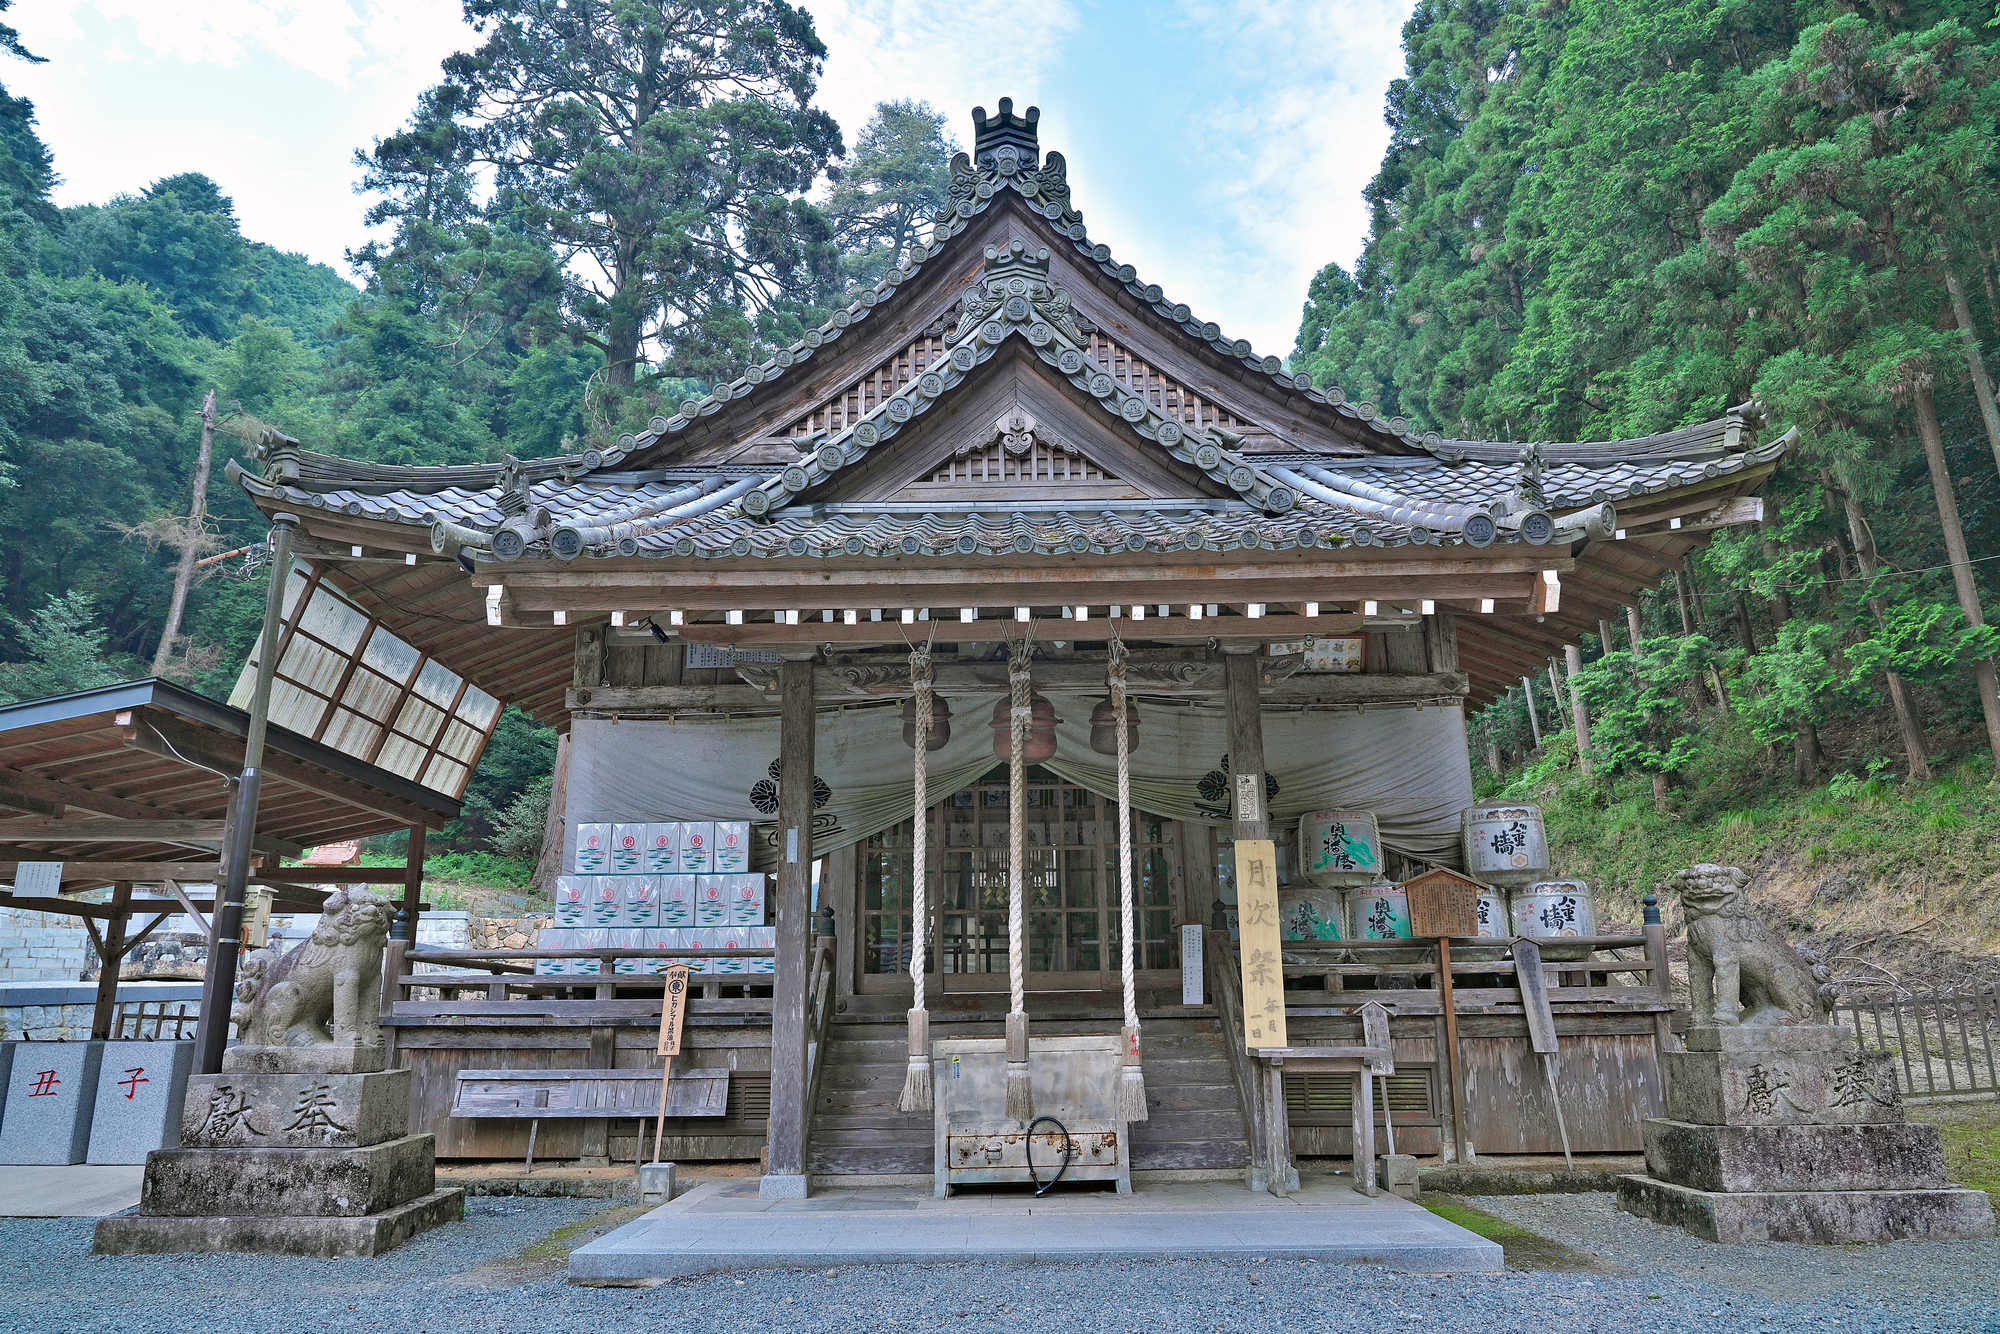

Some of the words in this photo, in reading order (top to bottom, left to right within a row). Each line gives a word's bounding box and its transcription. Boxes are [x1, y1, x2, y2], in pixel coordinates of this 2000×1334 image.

[1246, 858, 1276, 985] 月次祭
[1251, 1013, 1262, 1039] 一日
[28, 1069, 62, 1098] 丑
[117, 1067, 150, 1101] 子
